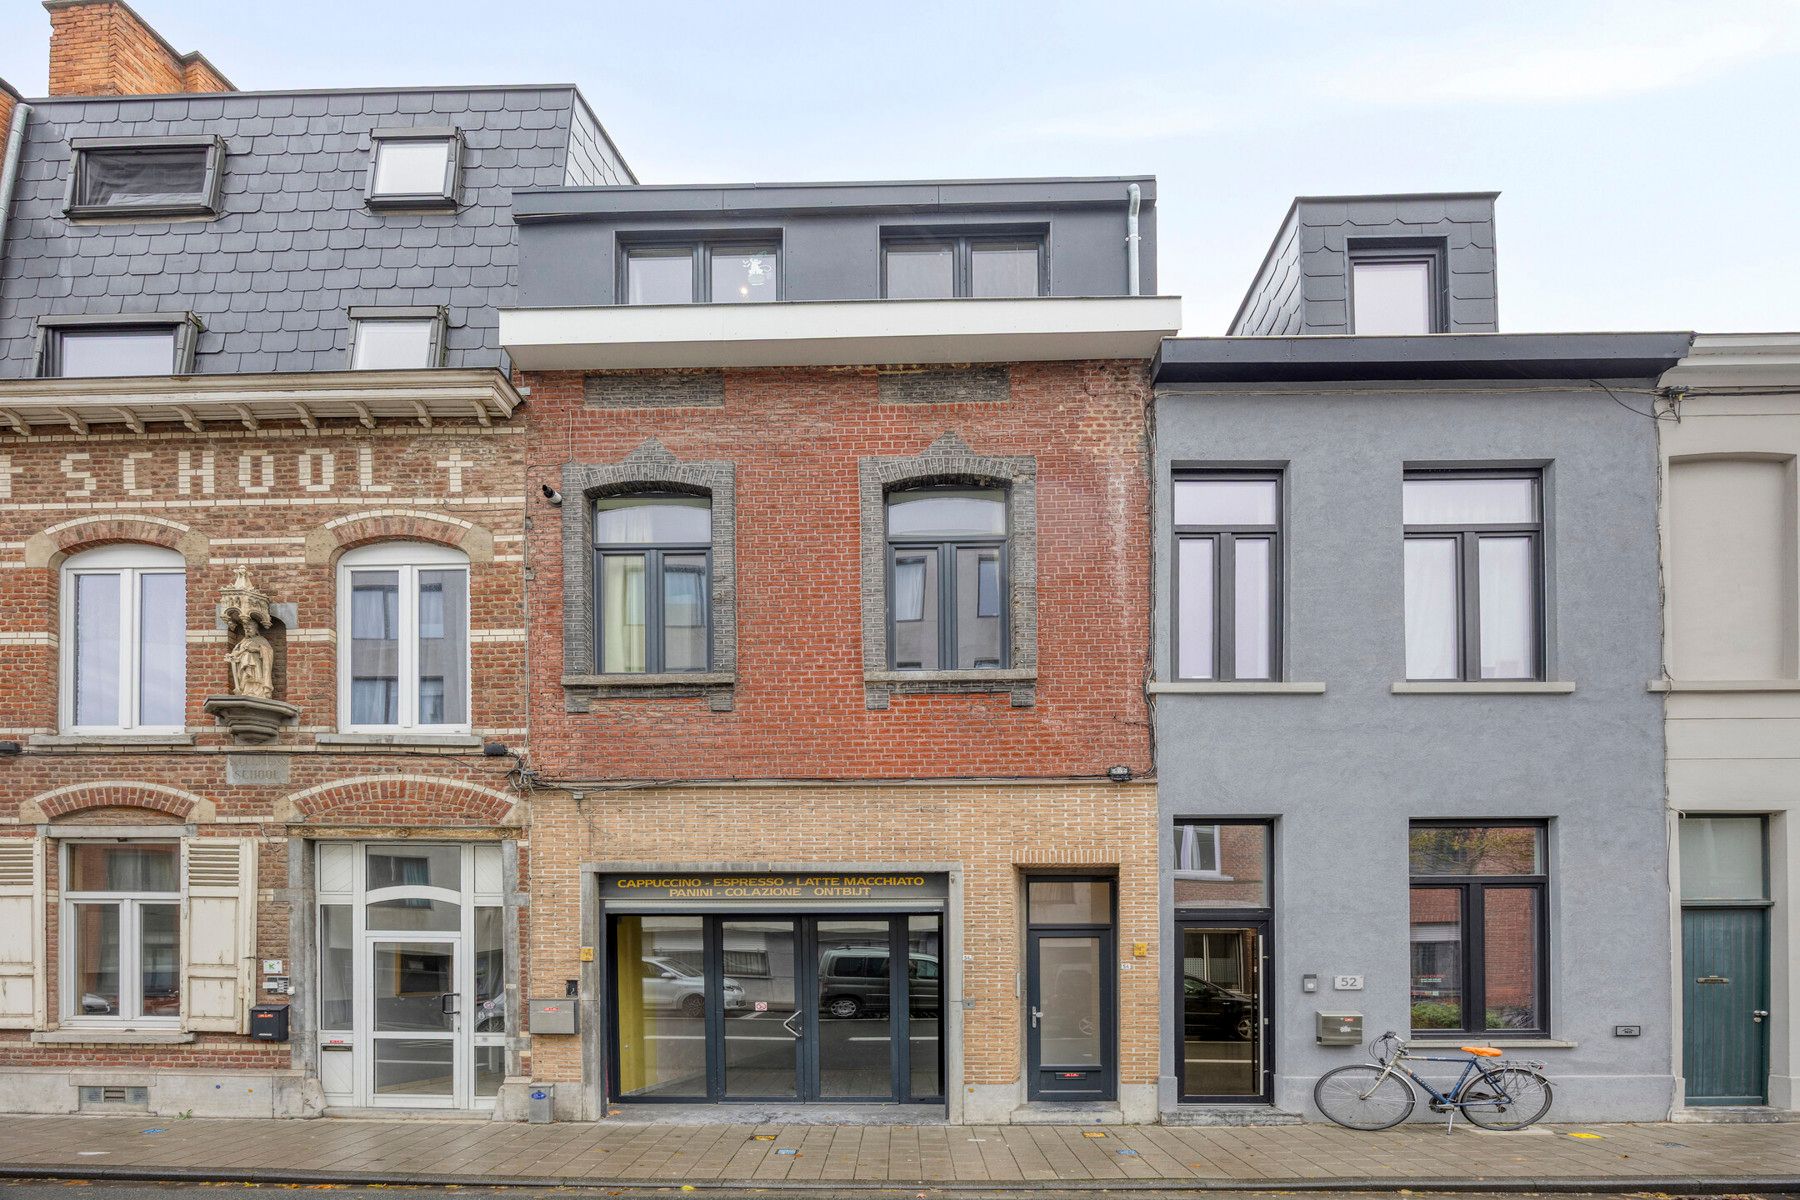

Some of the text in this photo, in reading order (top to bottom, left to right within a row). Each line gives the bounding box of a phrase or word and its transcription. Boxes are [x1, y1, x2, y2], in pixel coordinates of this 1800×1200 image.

[61, 448, 393, 498] SCHOOL
[617, 878, 701, 888] CAPPUCCINO
[713, 877, 784, 887] ESPRESSO
[796, 877, 840, 886] LATTE
[843, 876, 925, 886] MACCHIATO
[669, 888, 713, 897] PANINI
[724, 888, 801, 897] COLAZIONE
[814, 887, 871, 897] ONTBIJT
[1340, 977, 1357, 987] 52
